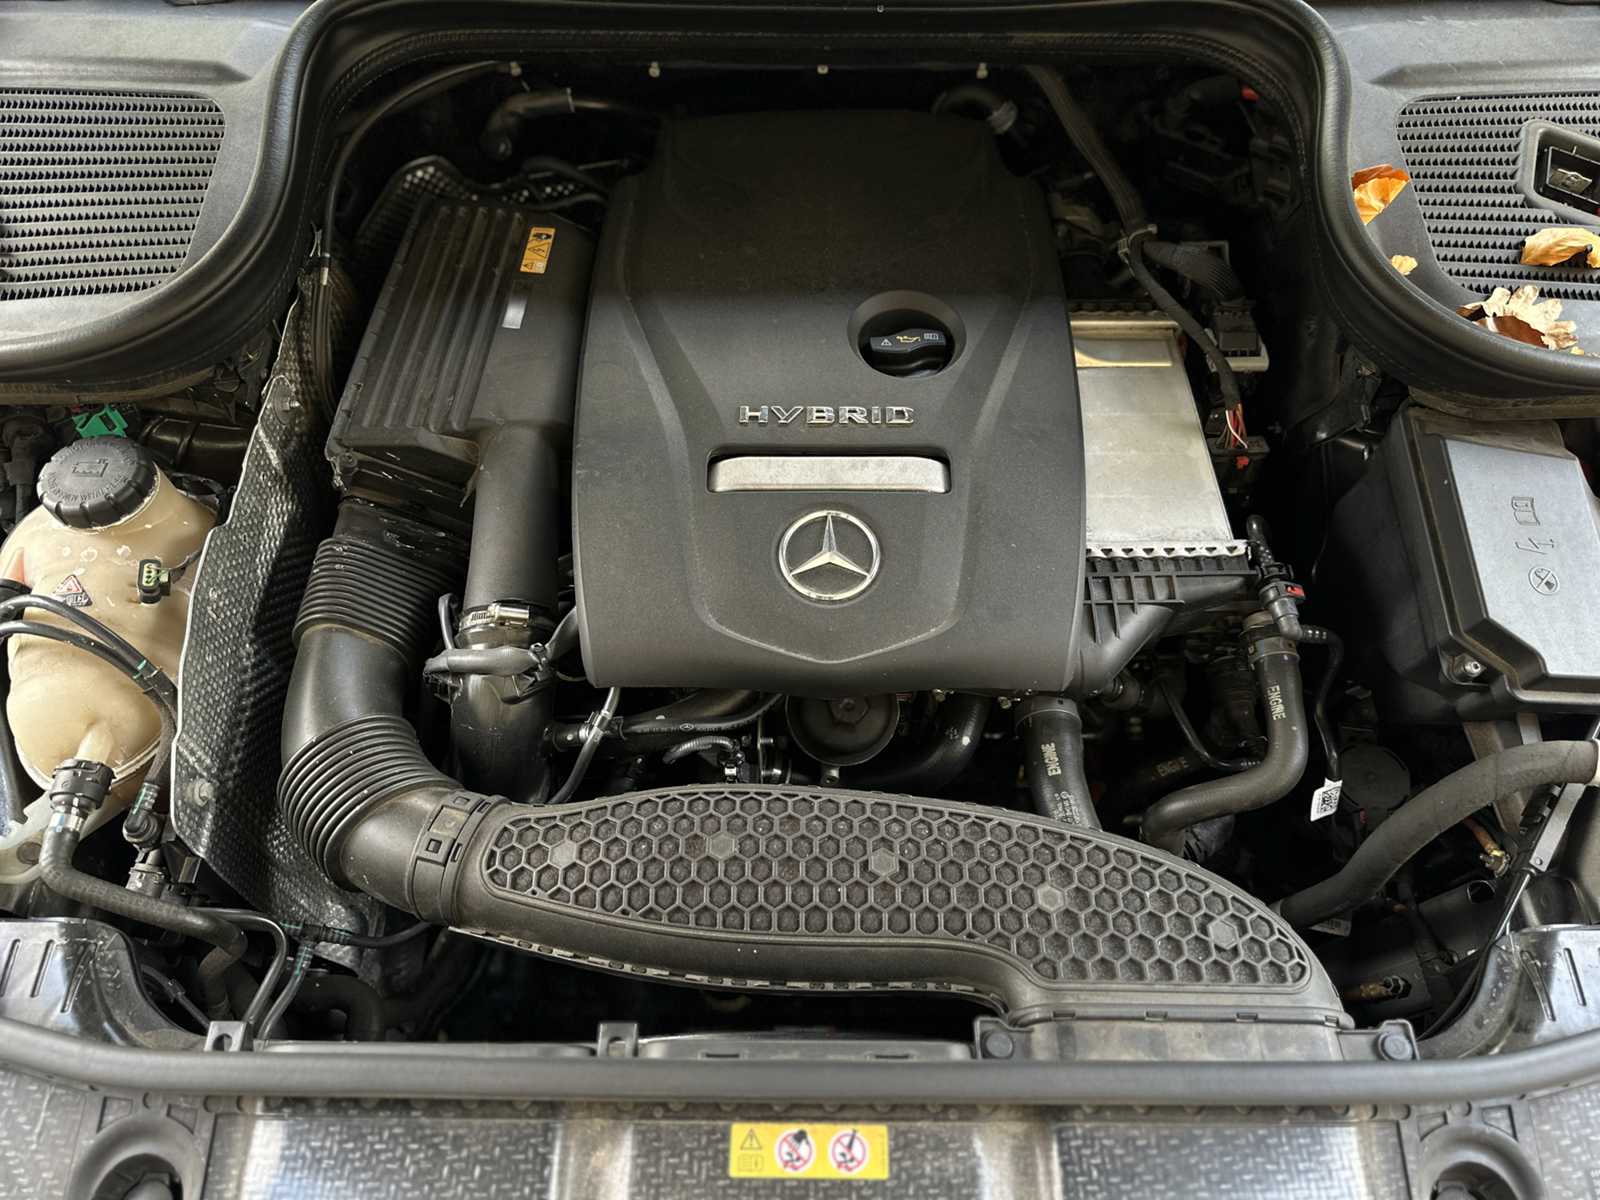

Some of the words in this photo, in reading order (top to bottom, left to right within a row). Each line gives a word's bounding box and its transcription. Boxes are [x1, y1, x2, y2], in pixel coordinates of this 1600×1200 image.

[738, 405, 915, 425] HYBRID
[1267, 685, 1287, 720] ENGINE
[1040, 742, 1062, 777] ENGINE
